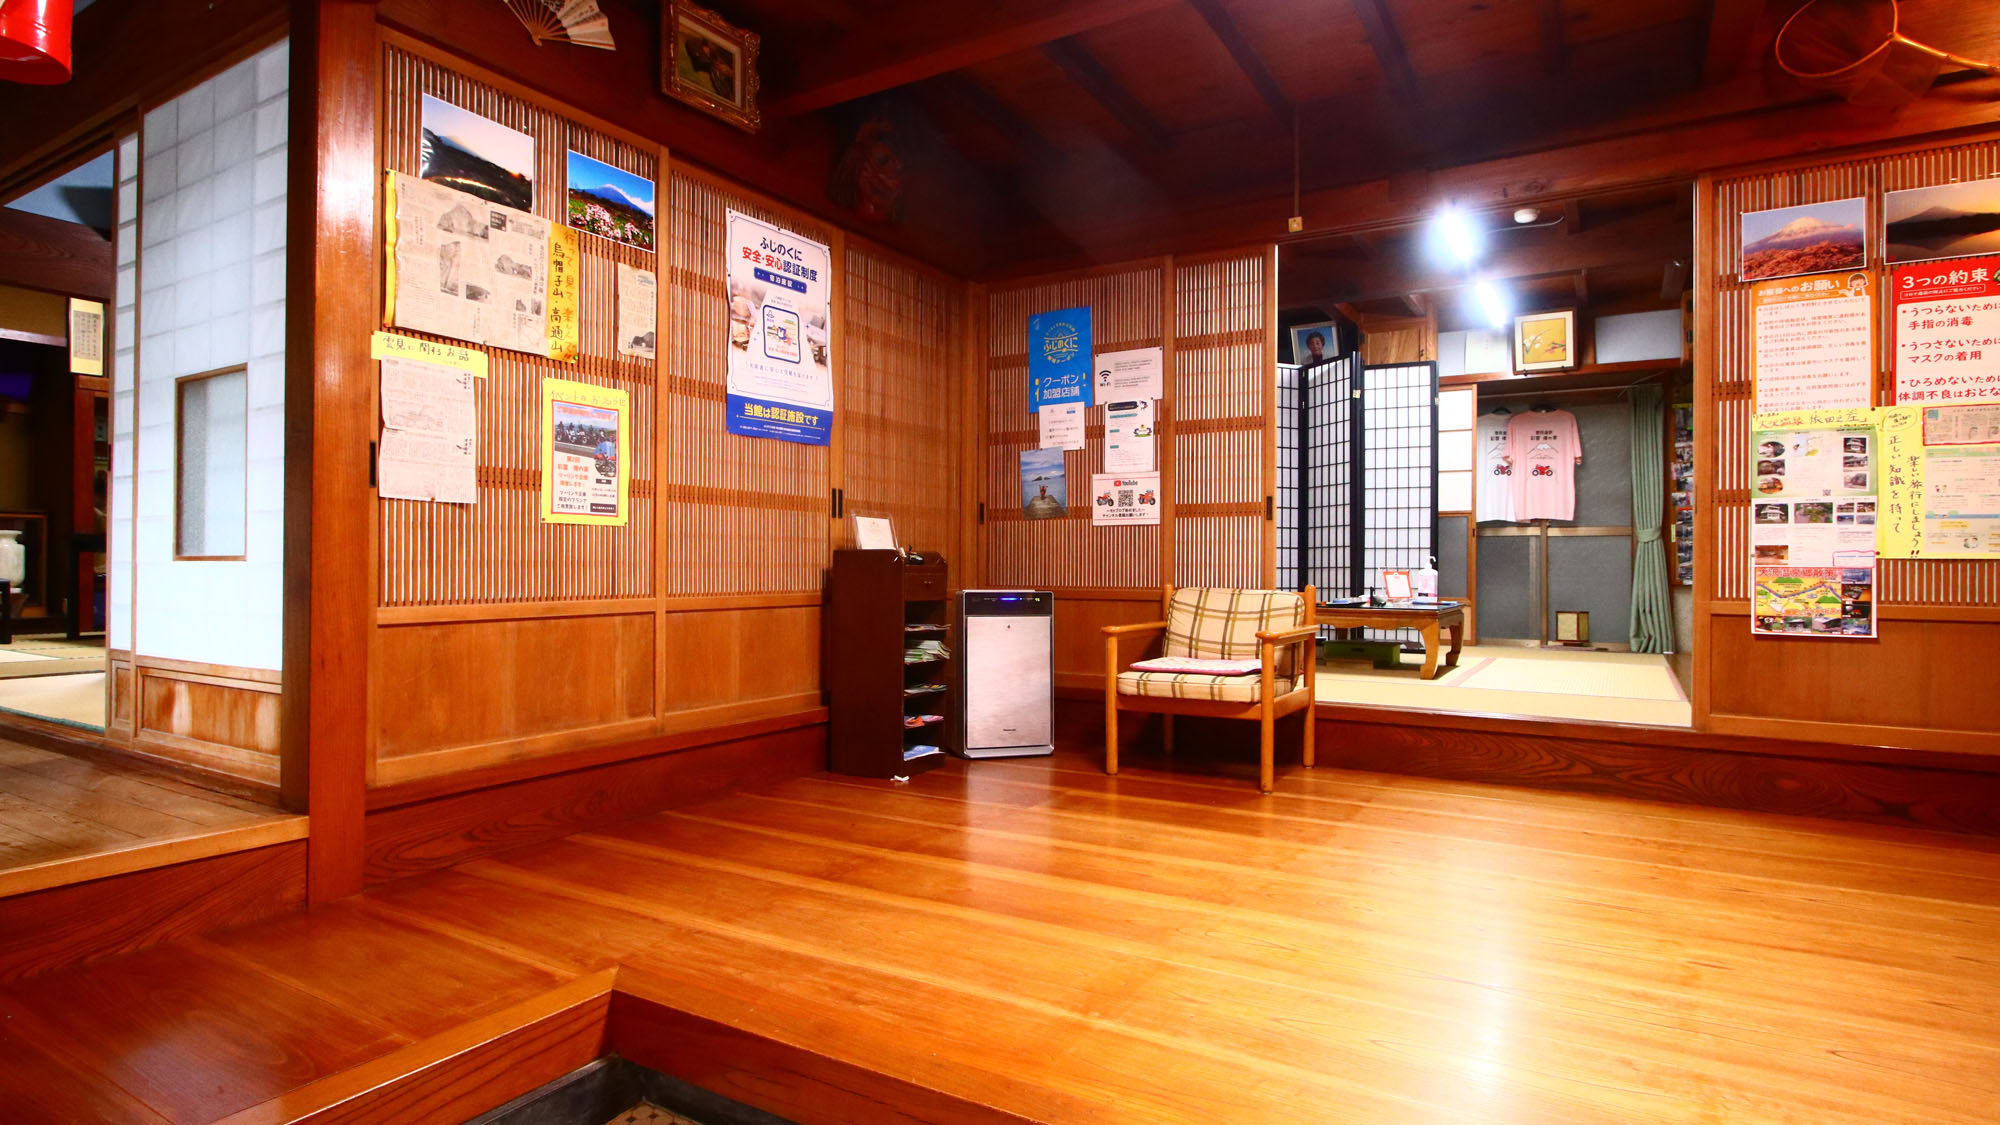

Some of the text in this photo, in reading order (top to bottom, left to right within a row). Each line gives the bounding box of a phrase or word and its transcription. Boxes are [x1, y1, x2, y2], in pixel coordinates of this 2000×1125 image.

[760, 237, 803, 262] ふじのくに
[742, 246, 818, 283] 安全・安心認証制度
[1901, 267, 1990, 289] 3つの約束
[1908, 315, 1974, 331] 手指の消毒
[1043, 337, 1078, 352] ふじのくに
[1907, 350, 1982, 364] マスクの着用
[1043, 374, 1079, 388] クーポン
[1043, 386, 1080, 400] 加盟店舗
[744, 402, 819, 427] 当館は認証施設です
